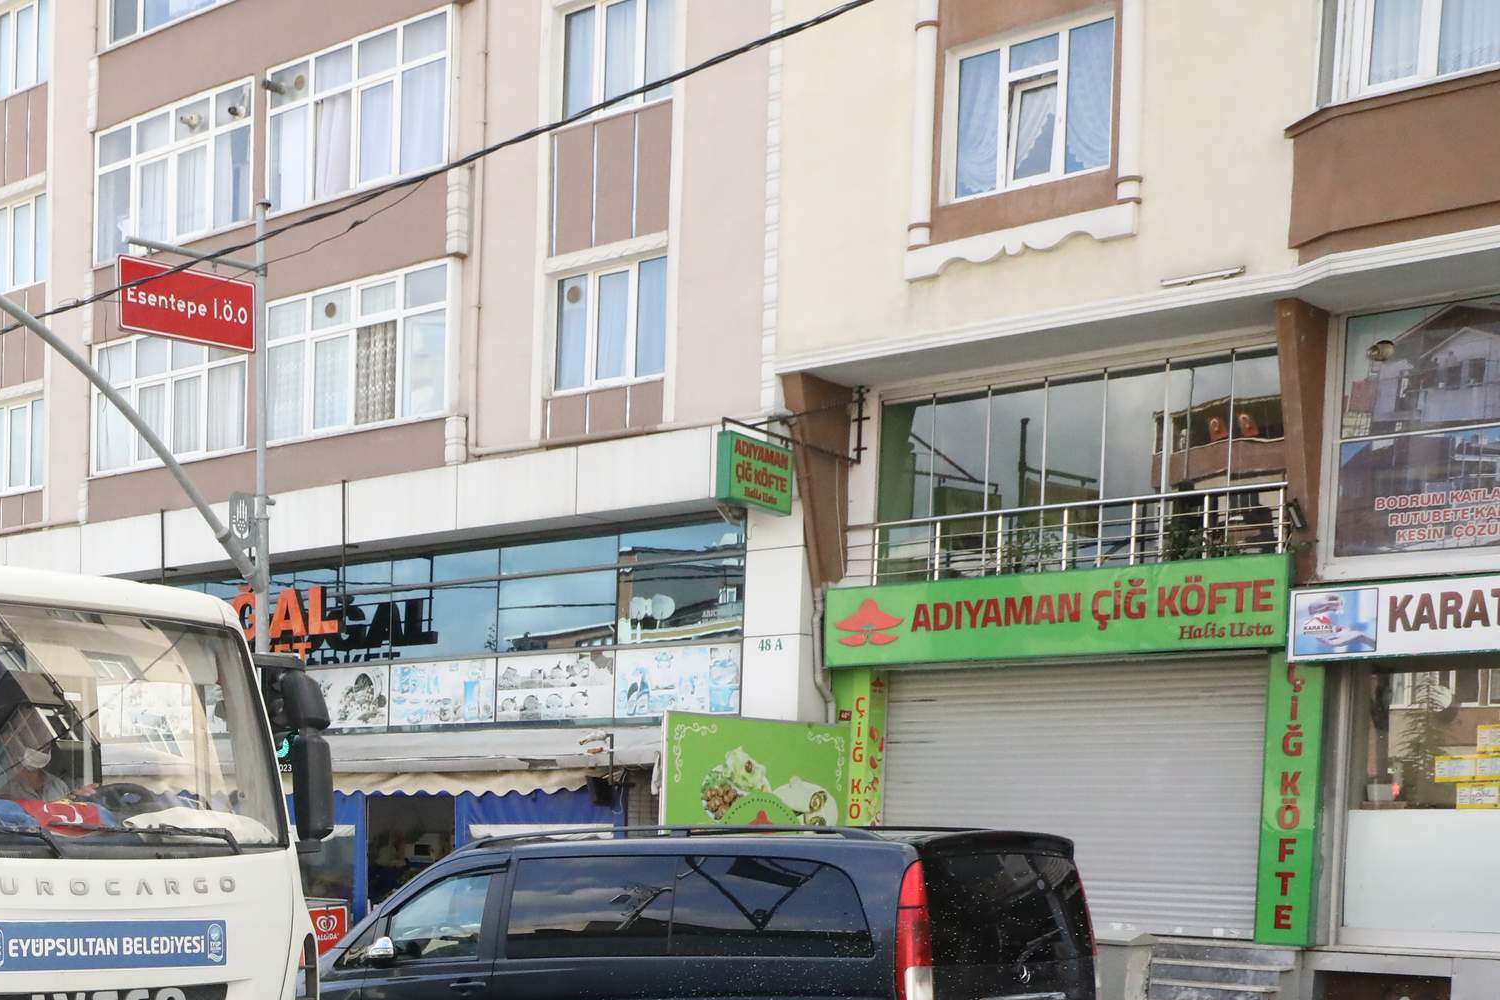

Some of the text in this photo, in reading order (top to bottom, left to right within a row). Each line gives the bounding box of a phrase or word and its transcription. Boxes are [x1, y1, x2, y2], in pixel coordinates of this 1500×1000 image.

[127, 287, 208, 318] Esentepe
[735, 438, 788, 470] ADIYAMAN
[755, 467, 787, 493] KÖFTE
[1375, 492, 1446, 510] BODRUM
[1388, 507, 1471, 527] RUTUBETE
[1396, 523, 1445, 544] KESİN
[910, 575, 1275, 632] ADIYAMAN ÇİĞ KÖFTE
[1177, 621, 1274, 640] Halis Usta
[758, 638, 783, 651] 48 A
[852, 696, 866, 763] ÇİĞ
[1274, 771, 1302, 930] KÖFTE
[8, 935, 205, 958] EYÜPSULTAN BELEDİYESİ
